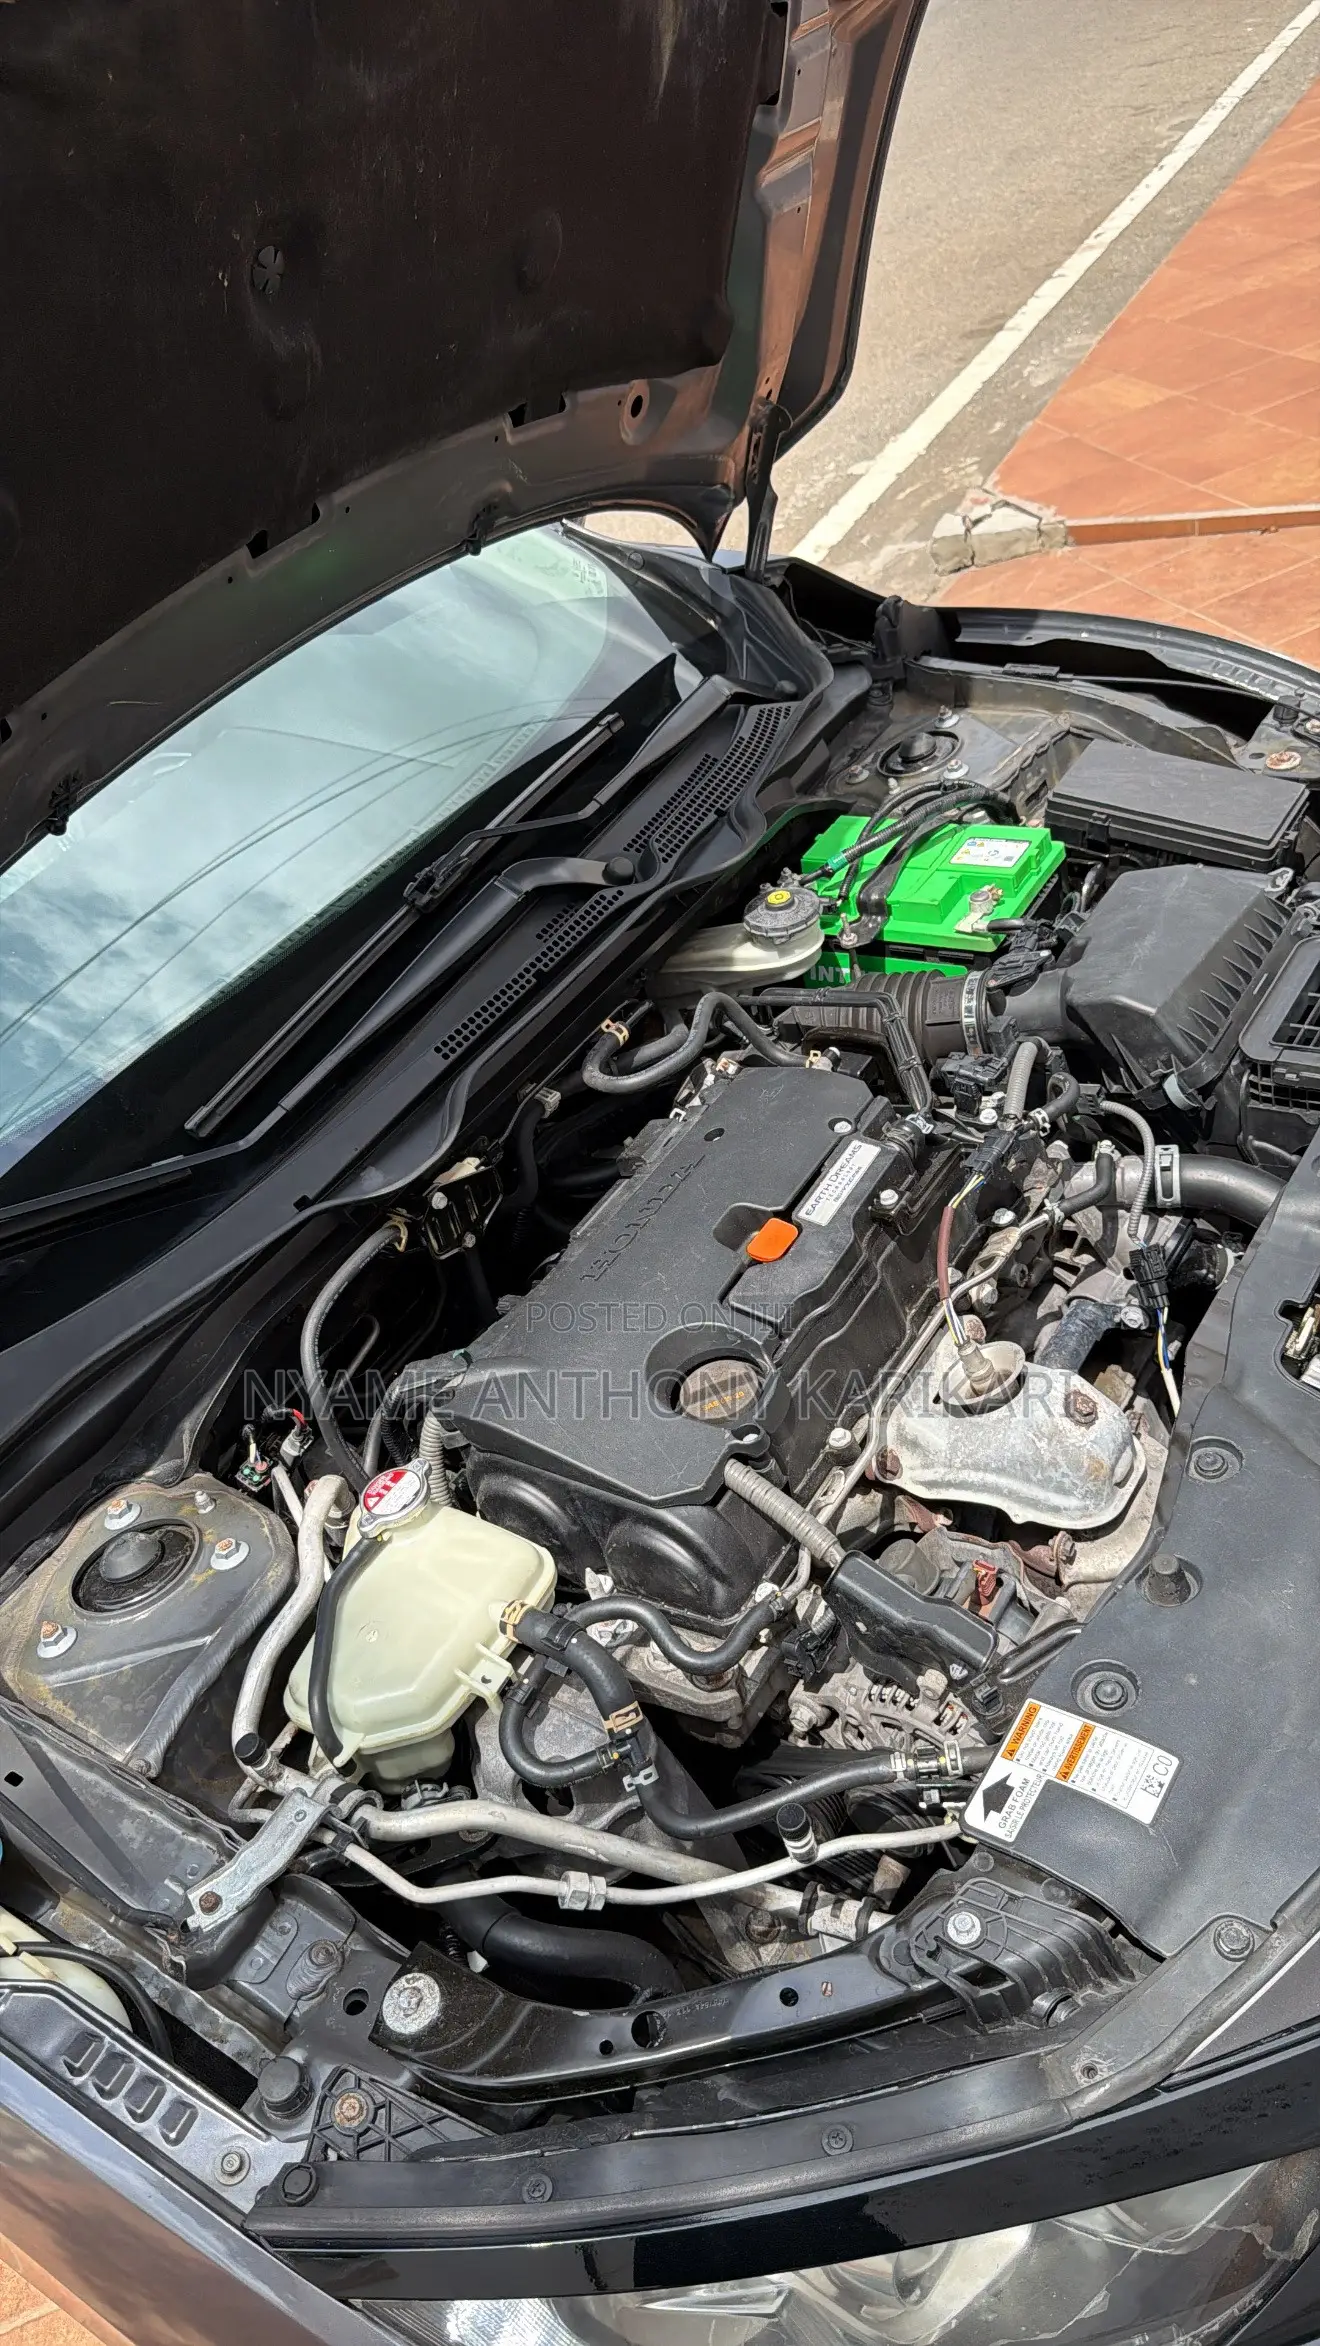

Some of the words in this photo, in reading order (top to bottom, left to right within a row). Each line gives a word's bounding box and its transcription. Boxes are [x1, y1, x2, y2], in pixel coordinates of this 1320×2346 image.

[803, 1183, 833, 1215] EARTH
[827, 1143, 862, 1182] DREAMS
[1014, 1706, 1037, 1745] WARNING
[1064, 1725, 1092, 1770] AVERTISSEMENT
[998, 1802, 1016, 1830] GRAB
[1012, 1777, 1030, 1804] FOAM
[1005, 1817, 1019, 1838] SAISIR
[1014, 1809, 1024, 1820] LE
[1021, 1773, 1043, 1811] PROTECTEUR
